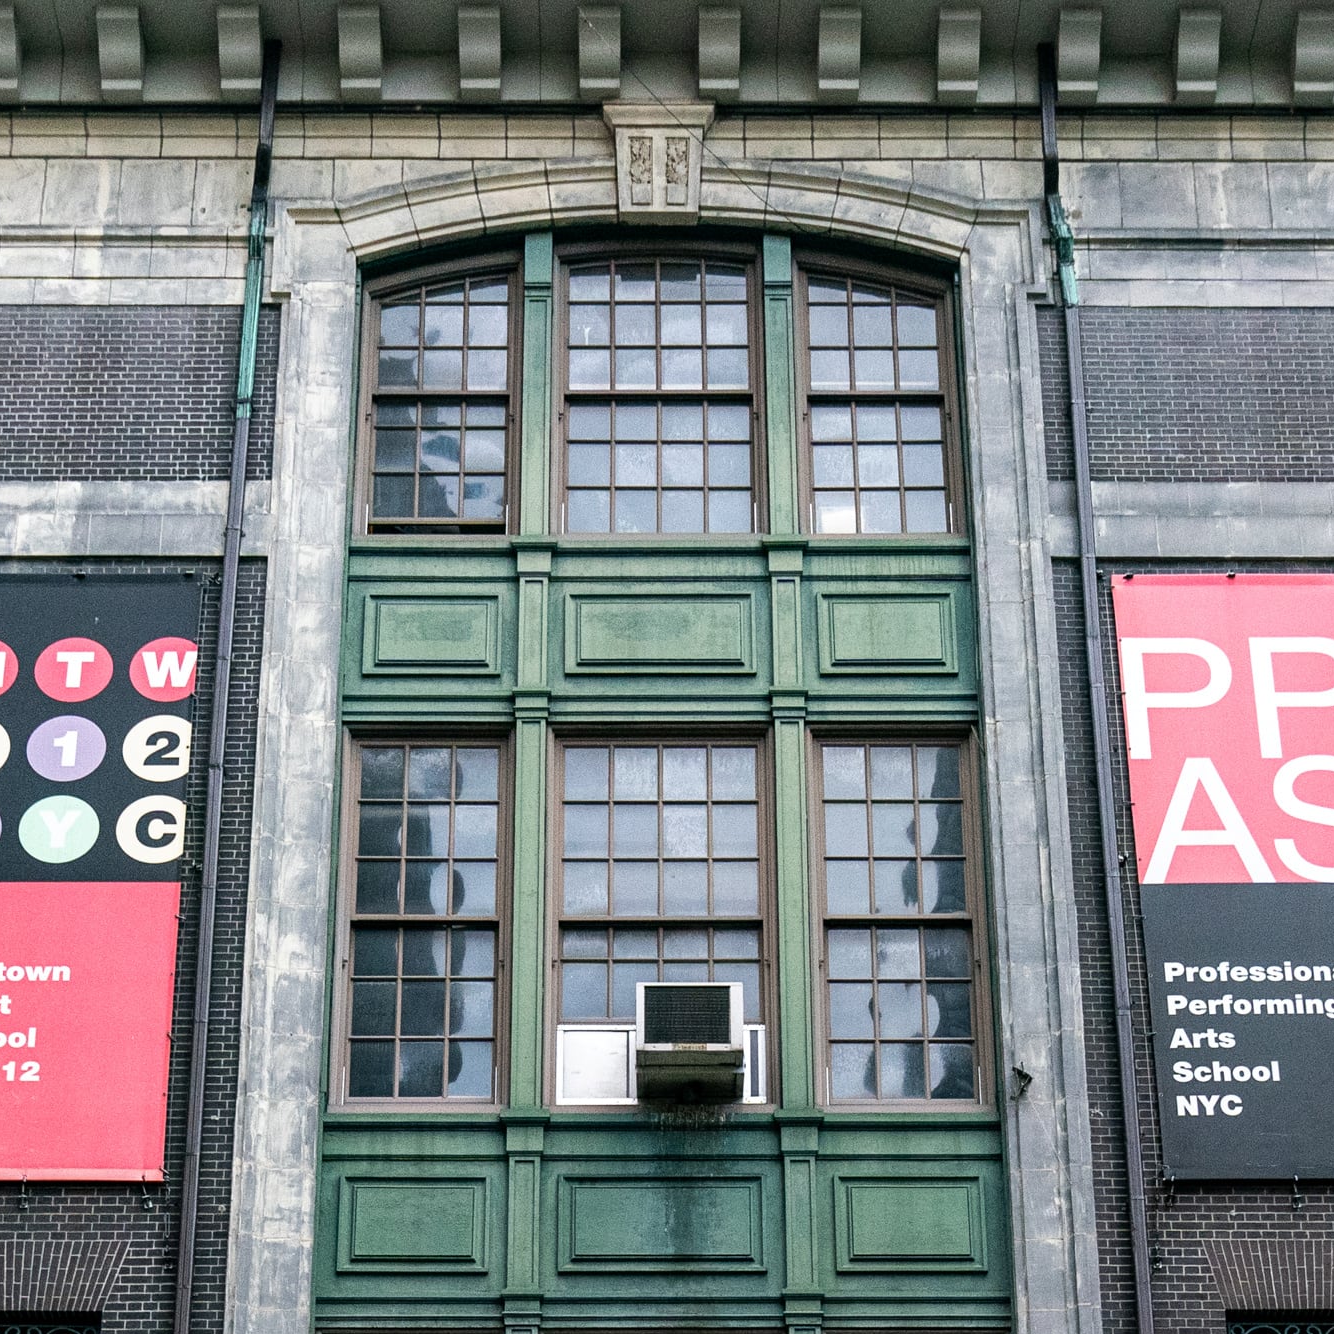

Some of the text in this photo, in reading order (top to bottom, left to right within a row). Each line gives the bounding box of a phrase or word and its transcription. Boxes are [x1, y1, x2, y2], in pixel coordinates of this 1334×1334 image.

[1169, 1028, 1236, 1049] Arts
[1172, 1061, 1281, 1082] School
[1176, 1094, 1244, 1116] NYC
